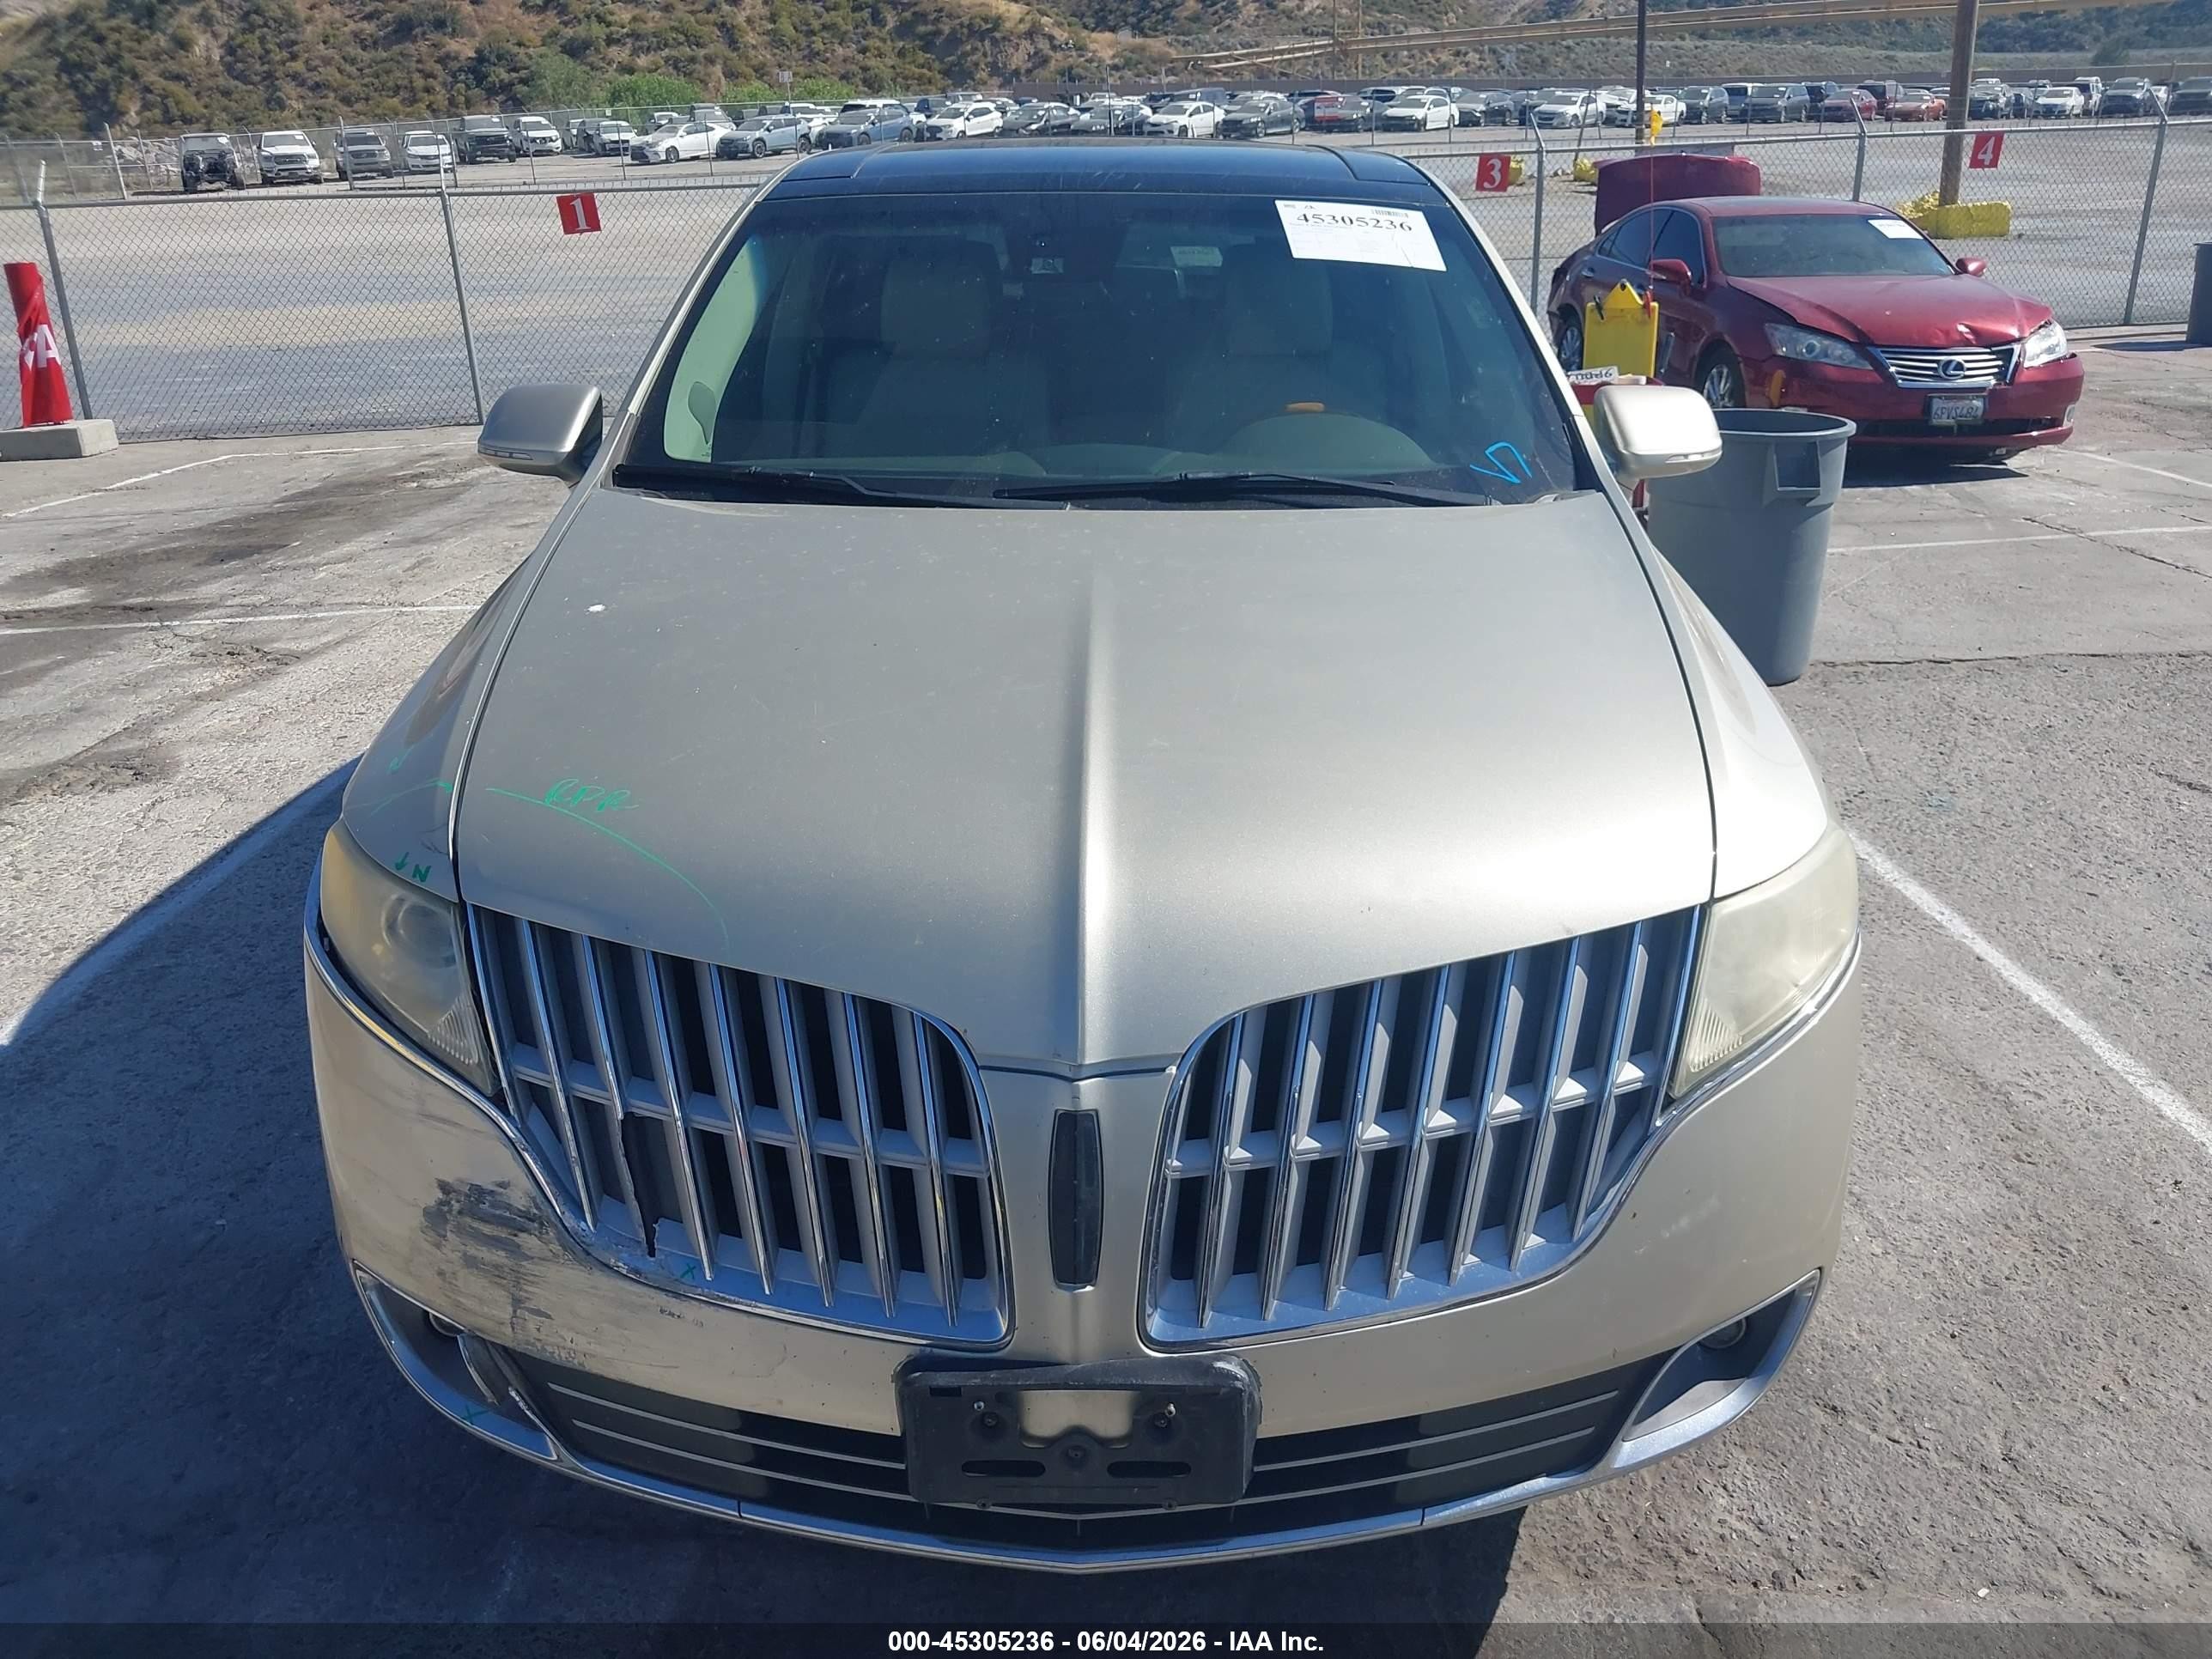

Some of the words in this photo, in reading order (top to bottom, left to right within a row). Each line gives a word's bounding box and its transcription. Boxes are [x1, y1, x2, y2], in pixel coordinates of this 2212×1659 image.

[1978, 137, 1996, 165] 4
[1483, 158, 1502, 189] 3
[569, 198, 591, 231] 1
[1296, 212, 1413, 232] 45305236
